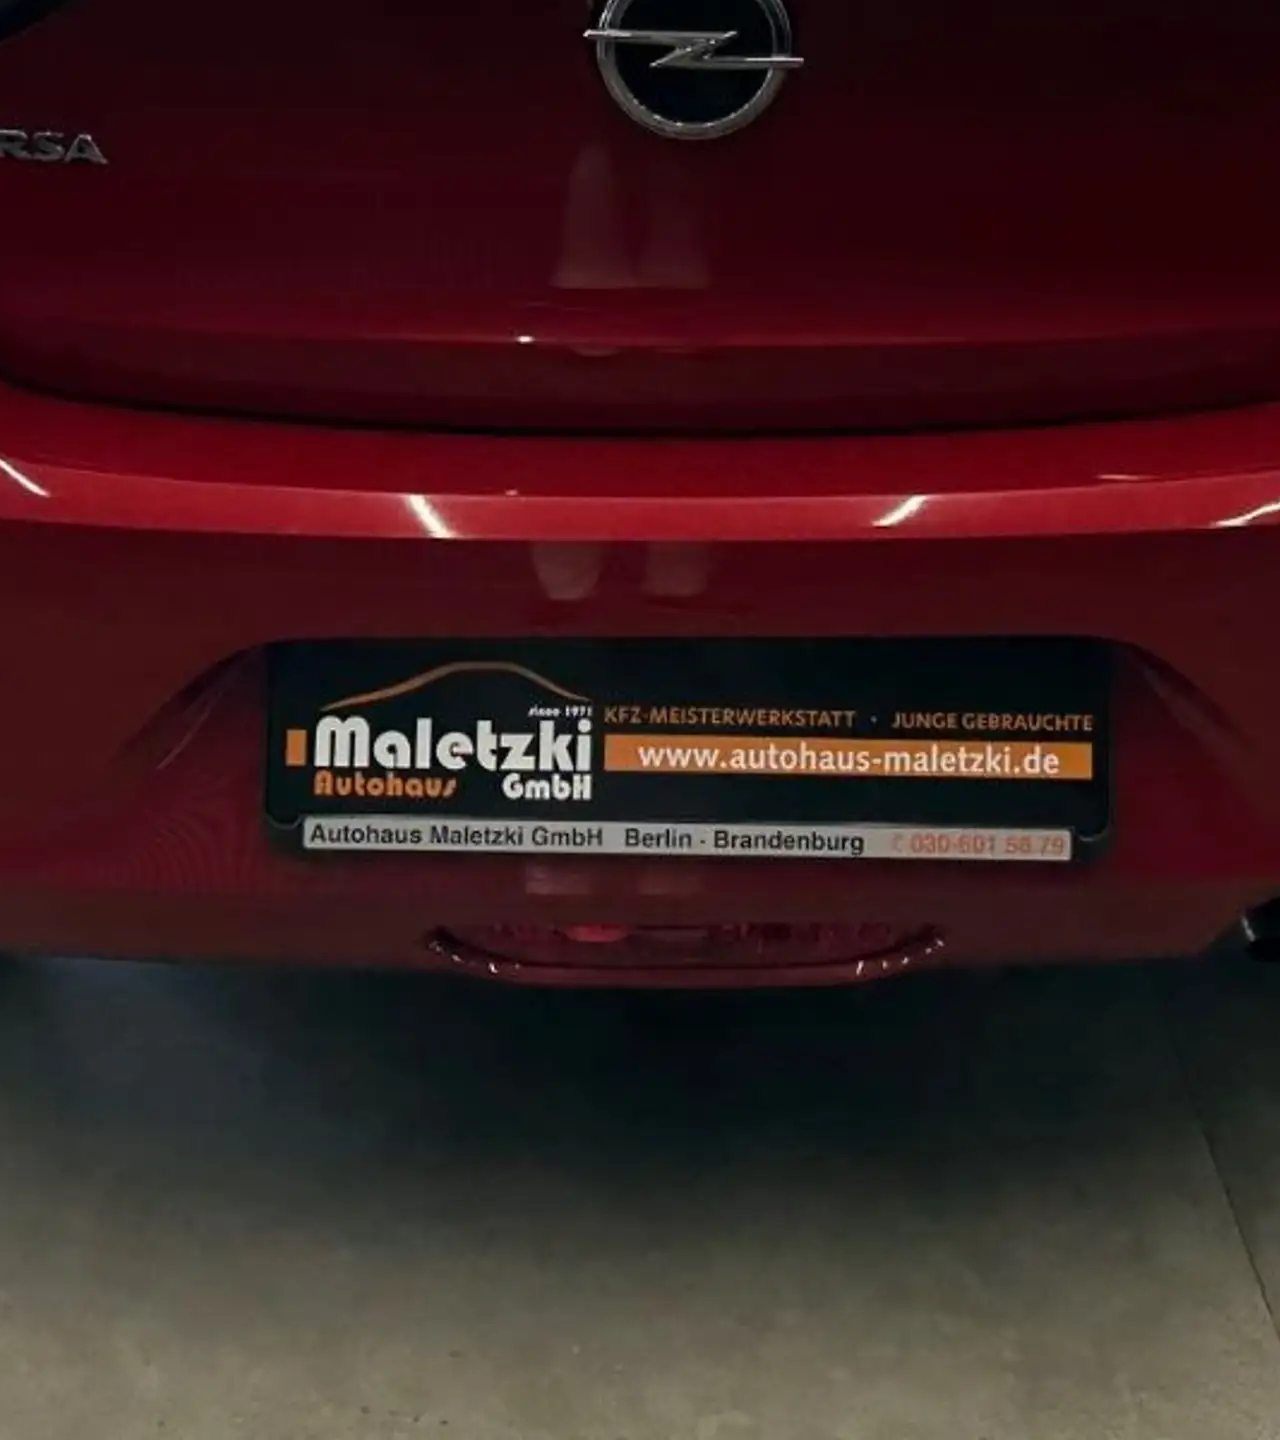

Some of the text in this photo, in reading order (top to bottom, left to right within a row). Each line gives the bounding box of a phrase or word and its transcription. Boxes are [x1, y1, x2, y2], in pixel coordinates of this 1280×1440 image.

[603, 705, 1094, 732] KFZ-MEISTERWERKSTATT JUNGE GEBRAUCHTE
[313, 714, 593, 772] Maletzki
[636, 741, 1061, 776] www.autohaus-maletzki.de
[313, 770, 458, 798] Autohaus
[501, 772, 593, 801] GmbH
[309, 824, 422, 845] Autohaus
[429, 824, 524, 847] Maletzki
[531, 825, 604, 847] GmbH
[624, 827, 692, 849] Berlin
[713, 829, 865, 857] Brandenburg
